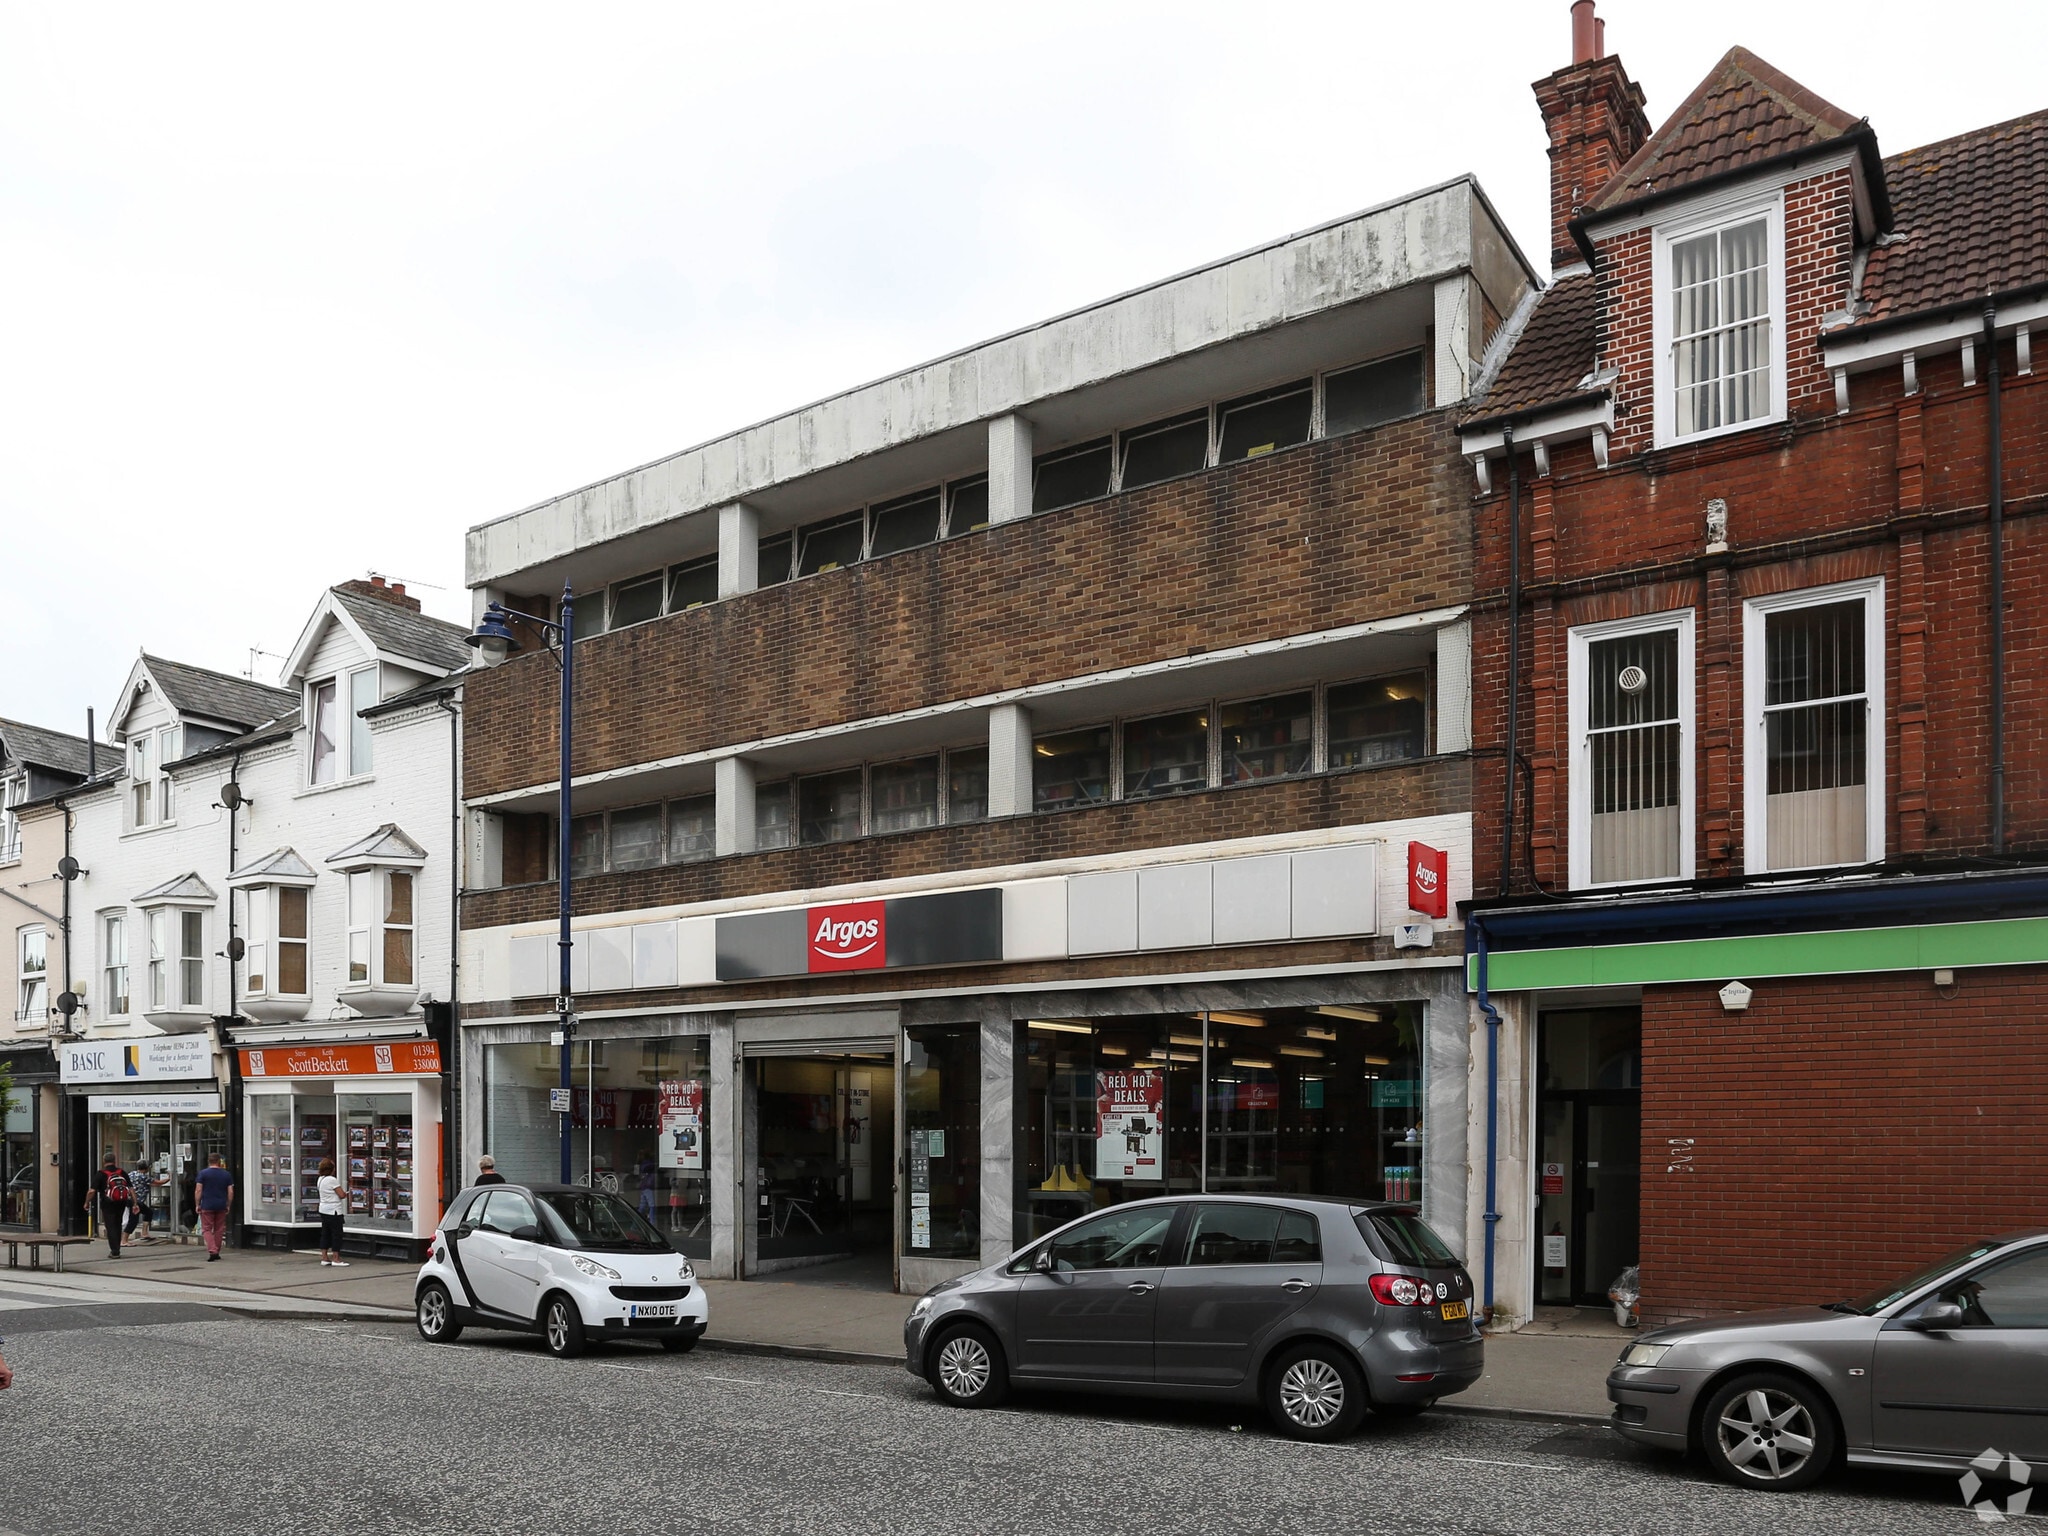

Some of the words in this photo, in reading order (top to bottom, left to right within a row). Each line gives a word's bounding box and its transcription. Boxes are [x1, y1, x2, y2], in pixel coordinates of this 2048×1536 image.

[1416, 862, 1437, 885] Argos
[813, 916, 879, 948] Argos
[153, 1044, 172, 1052] Telephone
[322, 1048, 334, 1056] Keith
[413, 1045, 435, 1057] 01394
[72, 1052, 105, 1071] BASIC
[149, 1054, 165, 1062] Working
[177, 1053, 189, 1061] better
[189, 1053, 203, 1062] future
[287, 1056, 349, 1073] ScottBeckett
[413, 1058, 439, 1071] 338000
[1108, 1075, 1129, 1089] RED.
[1132, 1075, 1153, 1088] HOT.
[666, 1084, 680, 1095] RED.
[682, 1084, 696, 1095] HOT.
[670, 1095, 692, 1106] DEALS.
[1114, 1089, 1147, 1103] DEALS.
[638, 1305, 658, 1316] NX10
[659, 1305, 675, 1315] OTE
